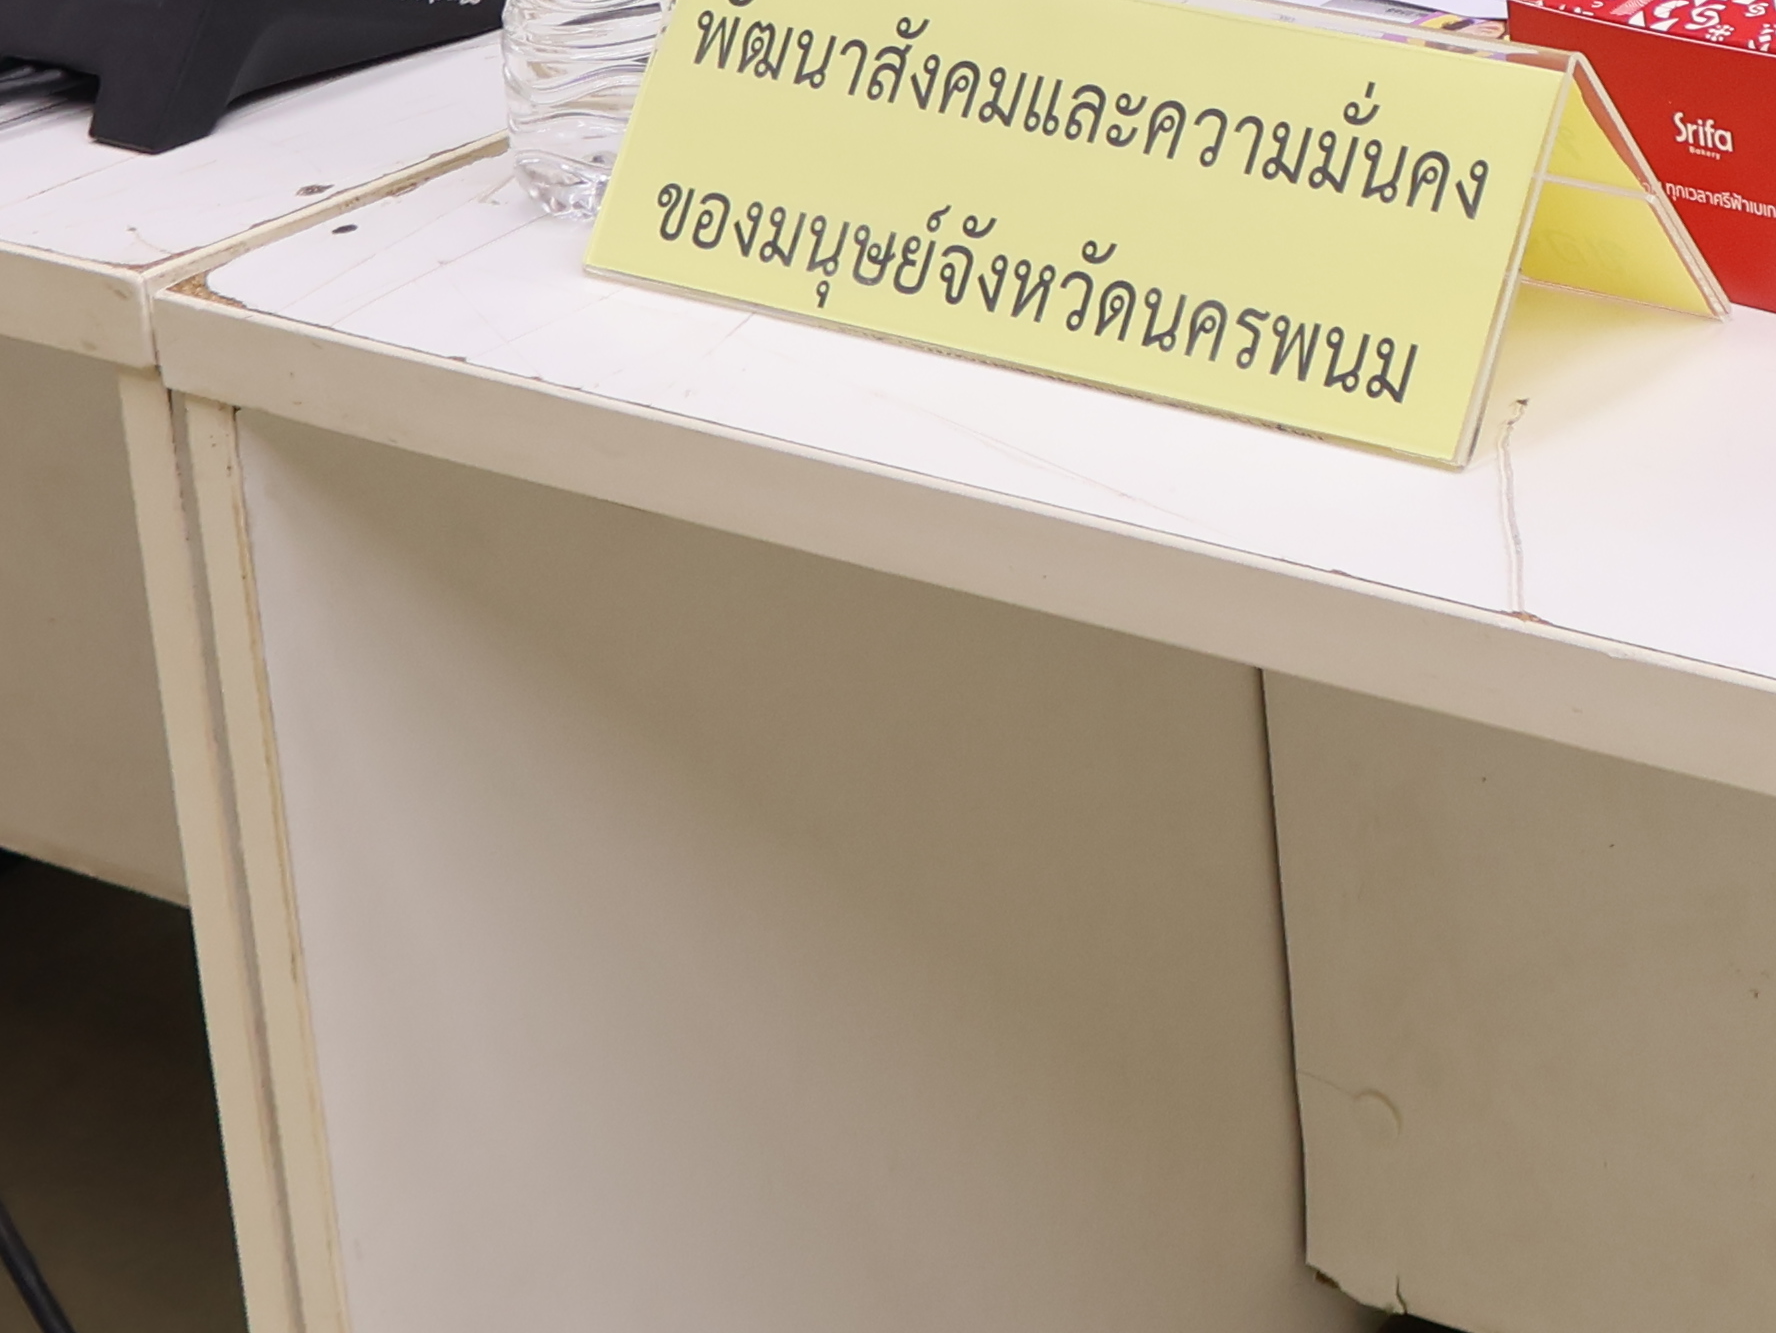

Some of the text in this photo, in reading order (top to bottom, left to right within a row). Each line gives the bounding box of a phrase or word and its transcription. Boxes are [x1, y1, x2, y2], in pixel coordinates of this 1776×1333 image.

[1673, 112, 1733, 153] Srifa
[656, 181, 1419, 405] ของมนุษย์จังหวัดนครพนม
